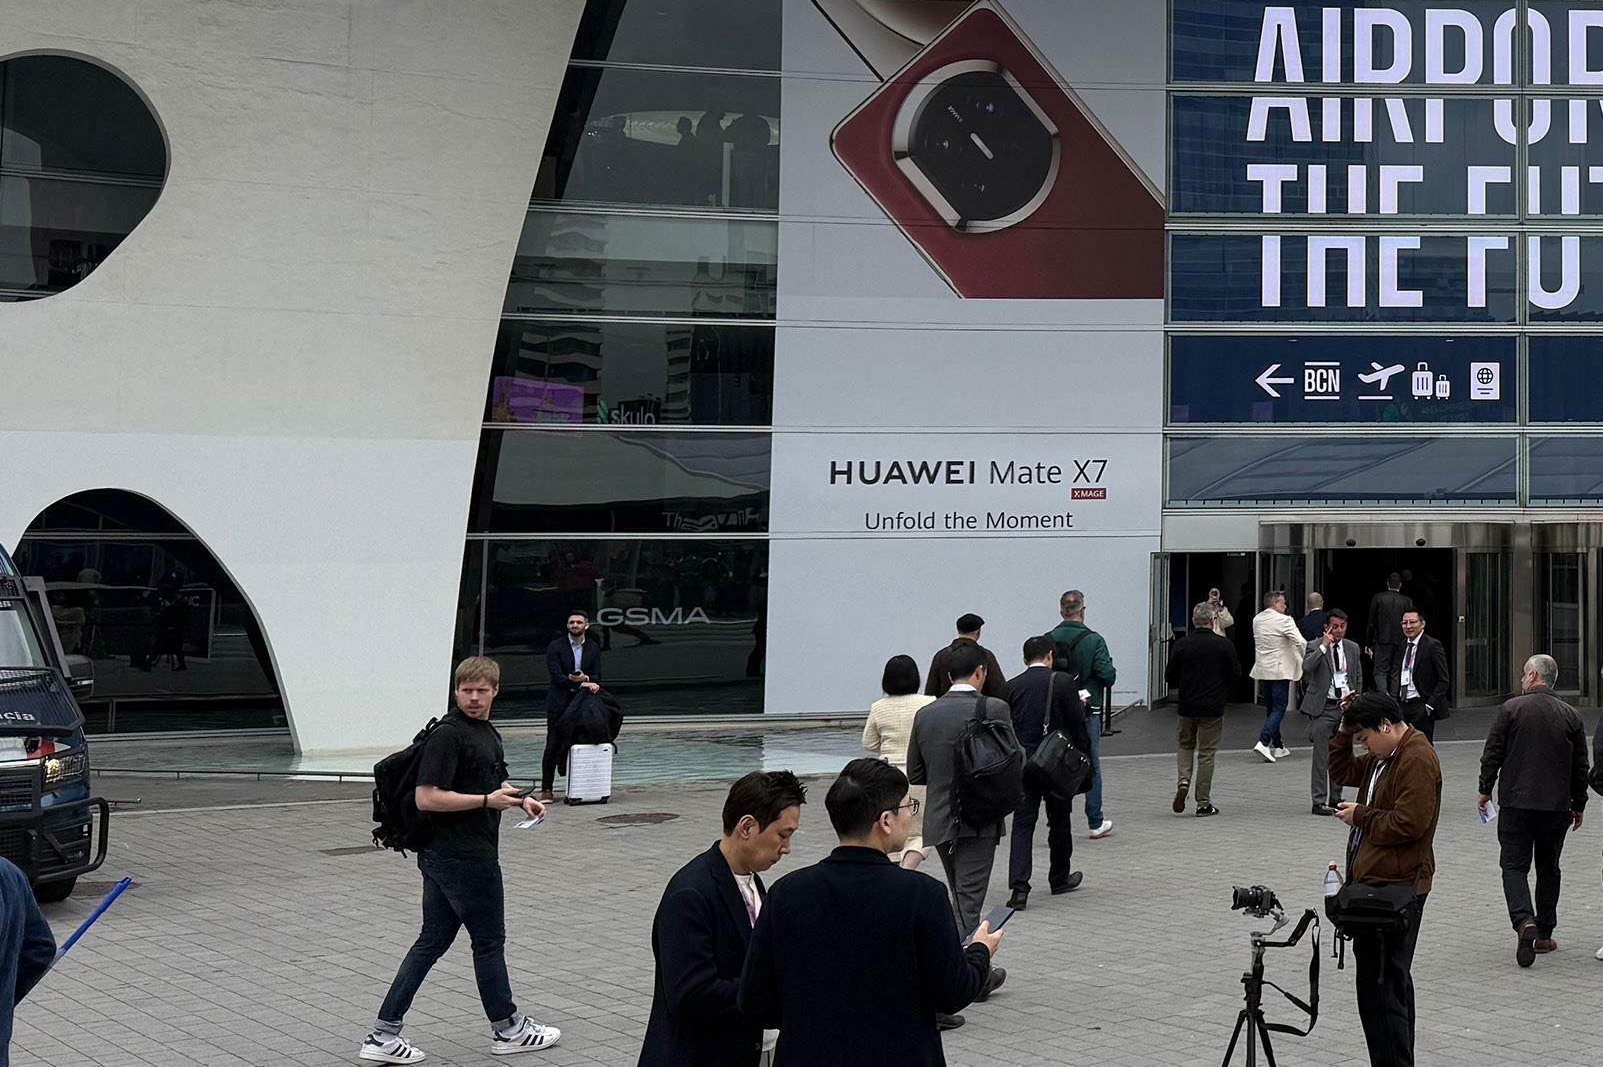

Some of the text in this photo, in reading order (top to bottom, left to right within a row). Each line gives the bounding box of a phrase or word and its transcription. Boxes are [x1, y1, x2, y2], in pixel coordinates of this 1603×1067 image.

[1246, 164, 1425, 308] THE
[1303, 368, 1341, 394] BCN
[829, 459, 1108, 485] HUAWEI Mate X7
[1073, 489, 1105, 499] XMAGE
[865, 511, 1073, 530] Unfold the Moment
[595, 606, 711, 626] GSMA
